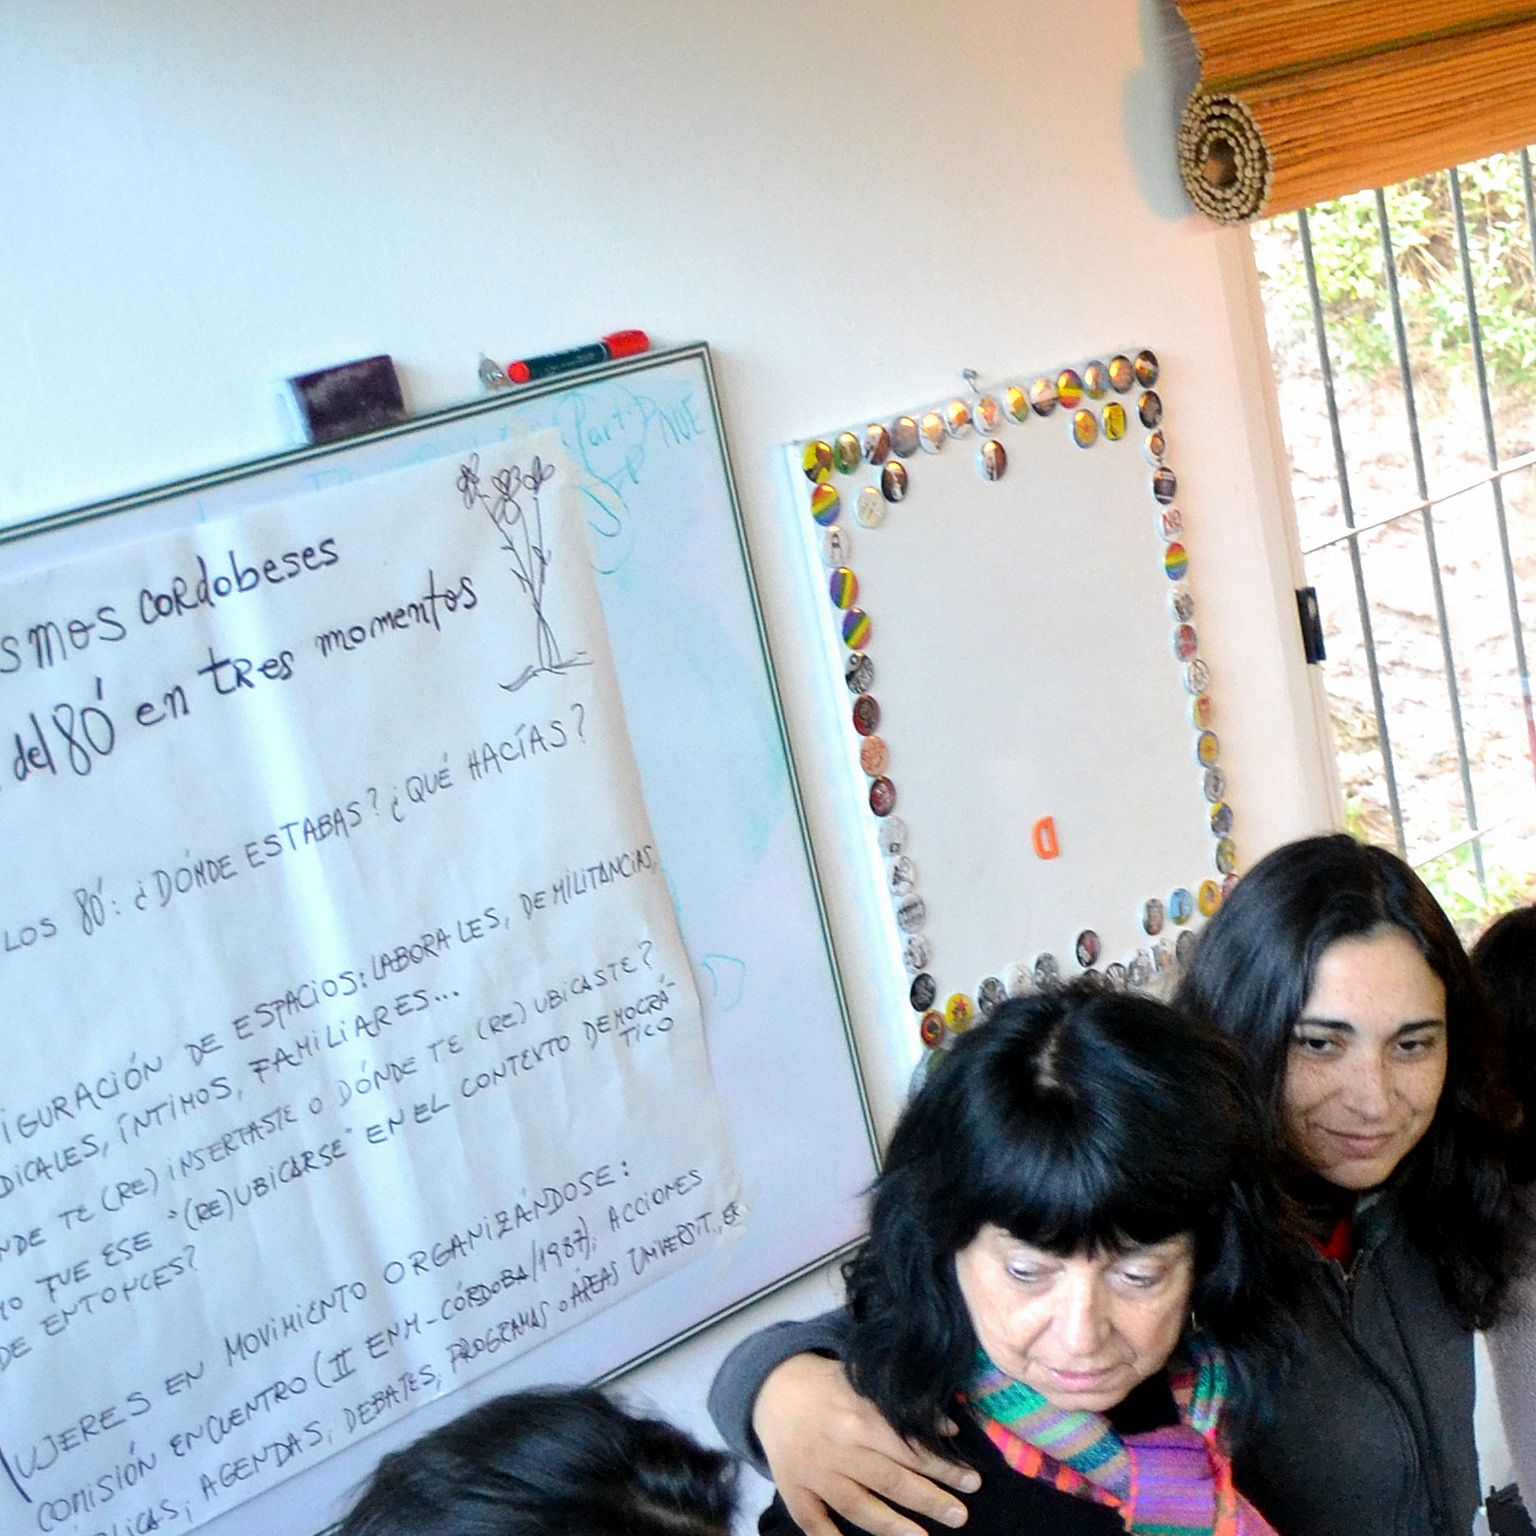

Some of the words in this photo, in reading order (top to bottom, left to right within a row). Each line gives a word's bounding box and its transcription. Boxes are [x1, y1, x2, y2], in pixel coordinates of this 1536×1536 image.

[13, 713, 55, 782] del
[135, 684, 190, 727] en
[316, 569, 478, 658] momentos
[2, 916, 58, 953] LOS
[244, 786, 380, 870] ESTABAS?
[184, 1033, 224, 1067] DE
[618, 1015, 675, 1048] TICO
[58, 1203, 95, 1230] TE
[336, 1057, 419, 1107] DÓNDE
[427, 1034, 464, 1064] TE
[101, 1230, 154, 1268] ESE
[366, 1108, 406, 1145] EN
[414, 1094, 452, 1125] EL
[460, 1032, 572, 1100] CONTEXTO
[0, 1335, 33, 1373] DE
[164, 1361, 205, 1397] EN
[223, 1281, 368, 1368] MOVIMIENTO
[169, 1375, 308, 1458] ENCUENTRO
[607, 1167, 704, 1231] ACCIONES
